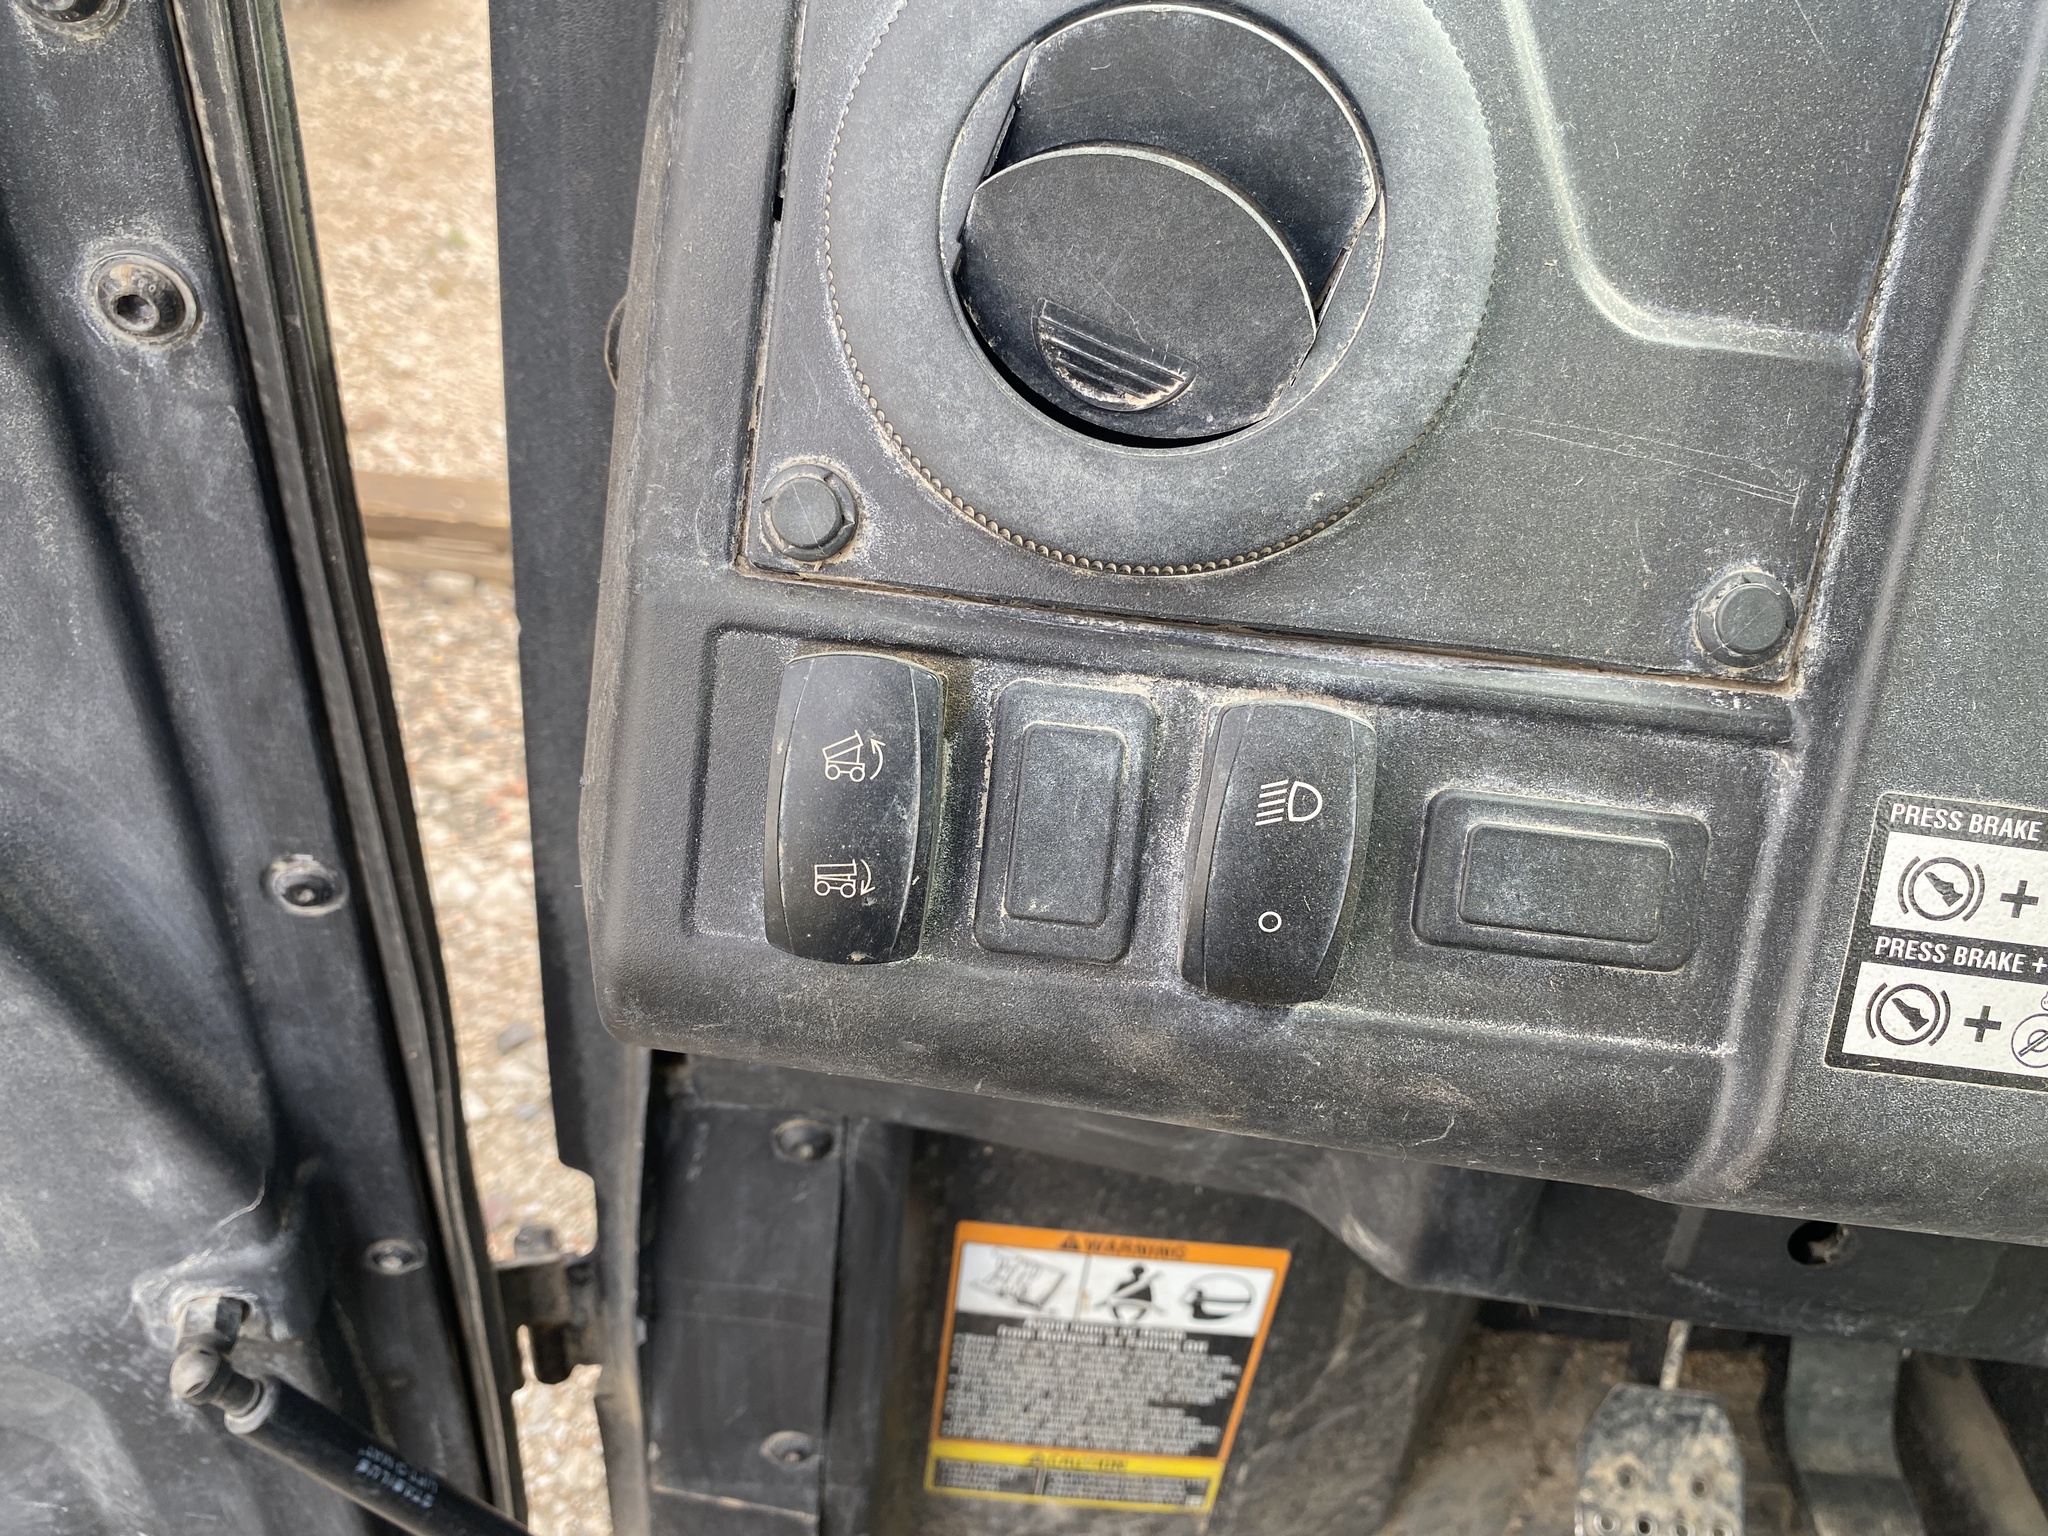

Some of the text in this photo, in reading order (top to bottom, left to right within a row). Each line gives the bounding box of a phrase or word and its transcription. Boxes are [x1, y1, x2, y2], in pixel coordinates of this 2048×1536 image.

[1890, 803, 2043, 842] PRESS BRAKE
[1874, 936, 1948, 965] PRESS
[1953, 945, 2027, 974] BRAKE
